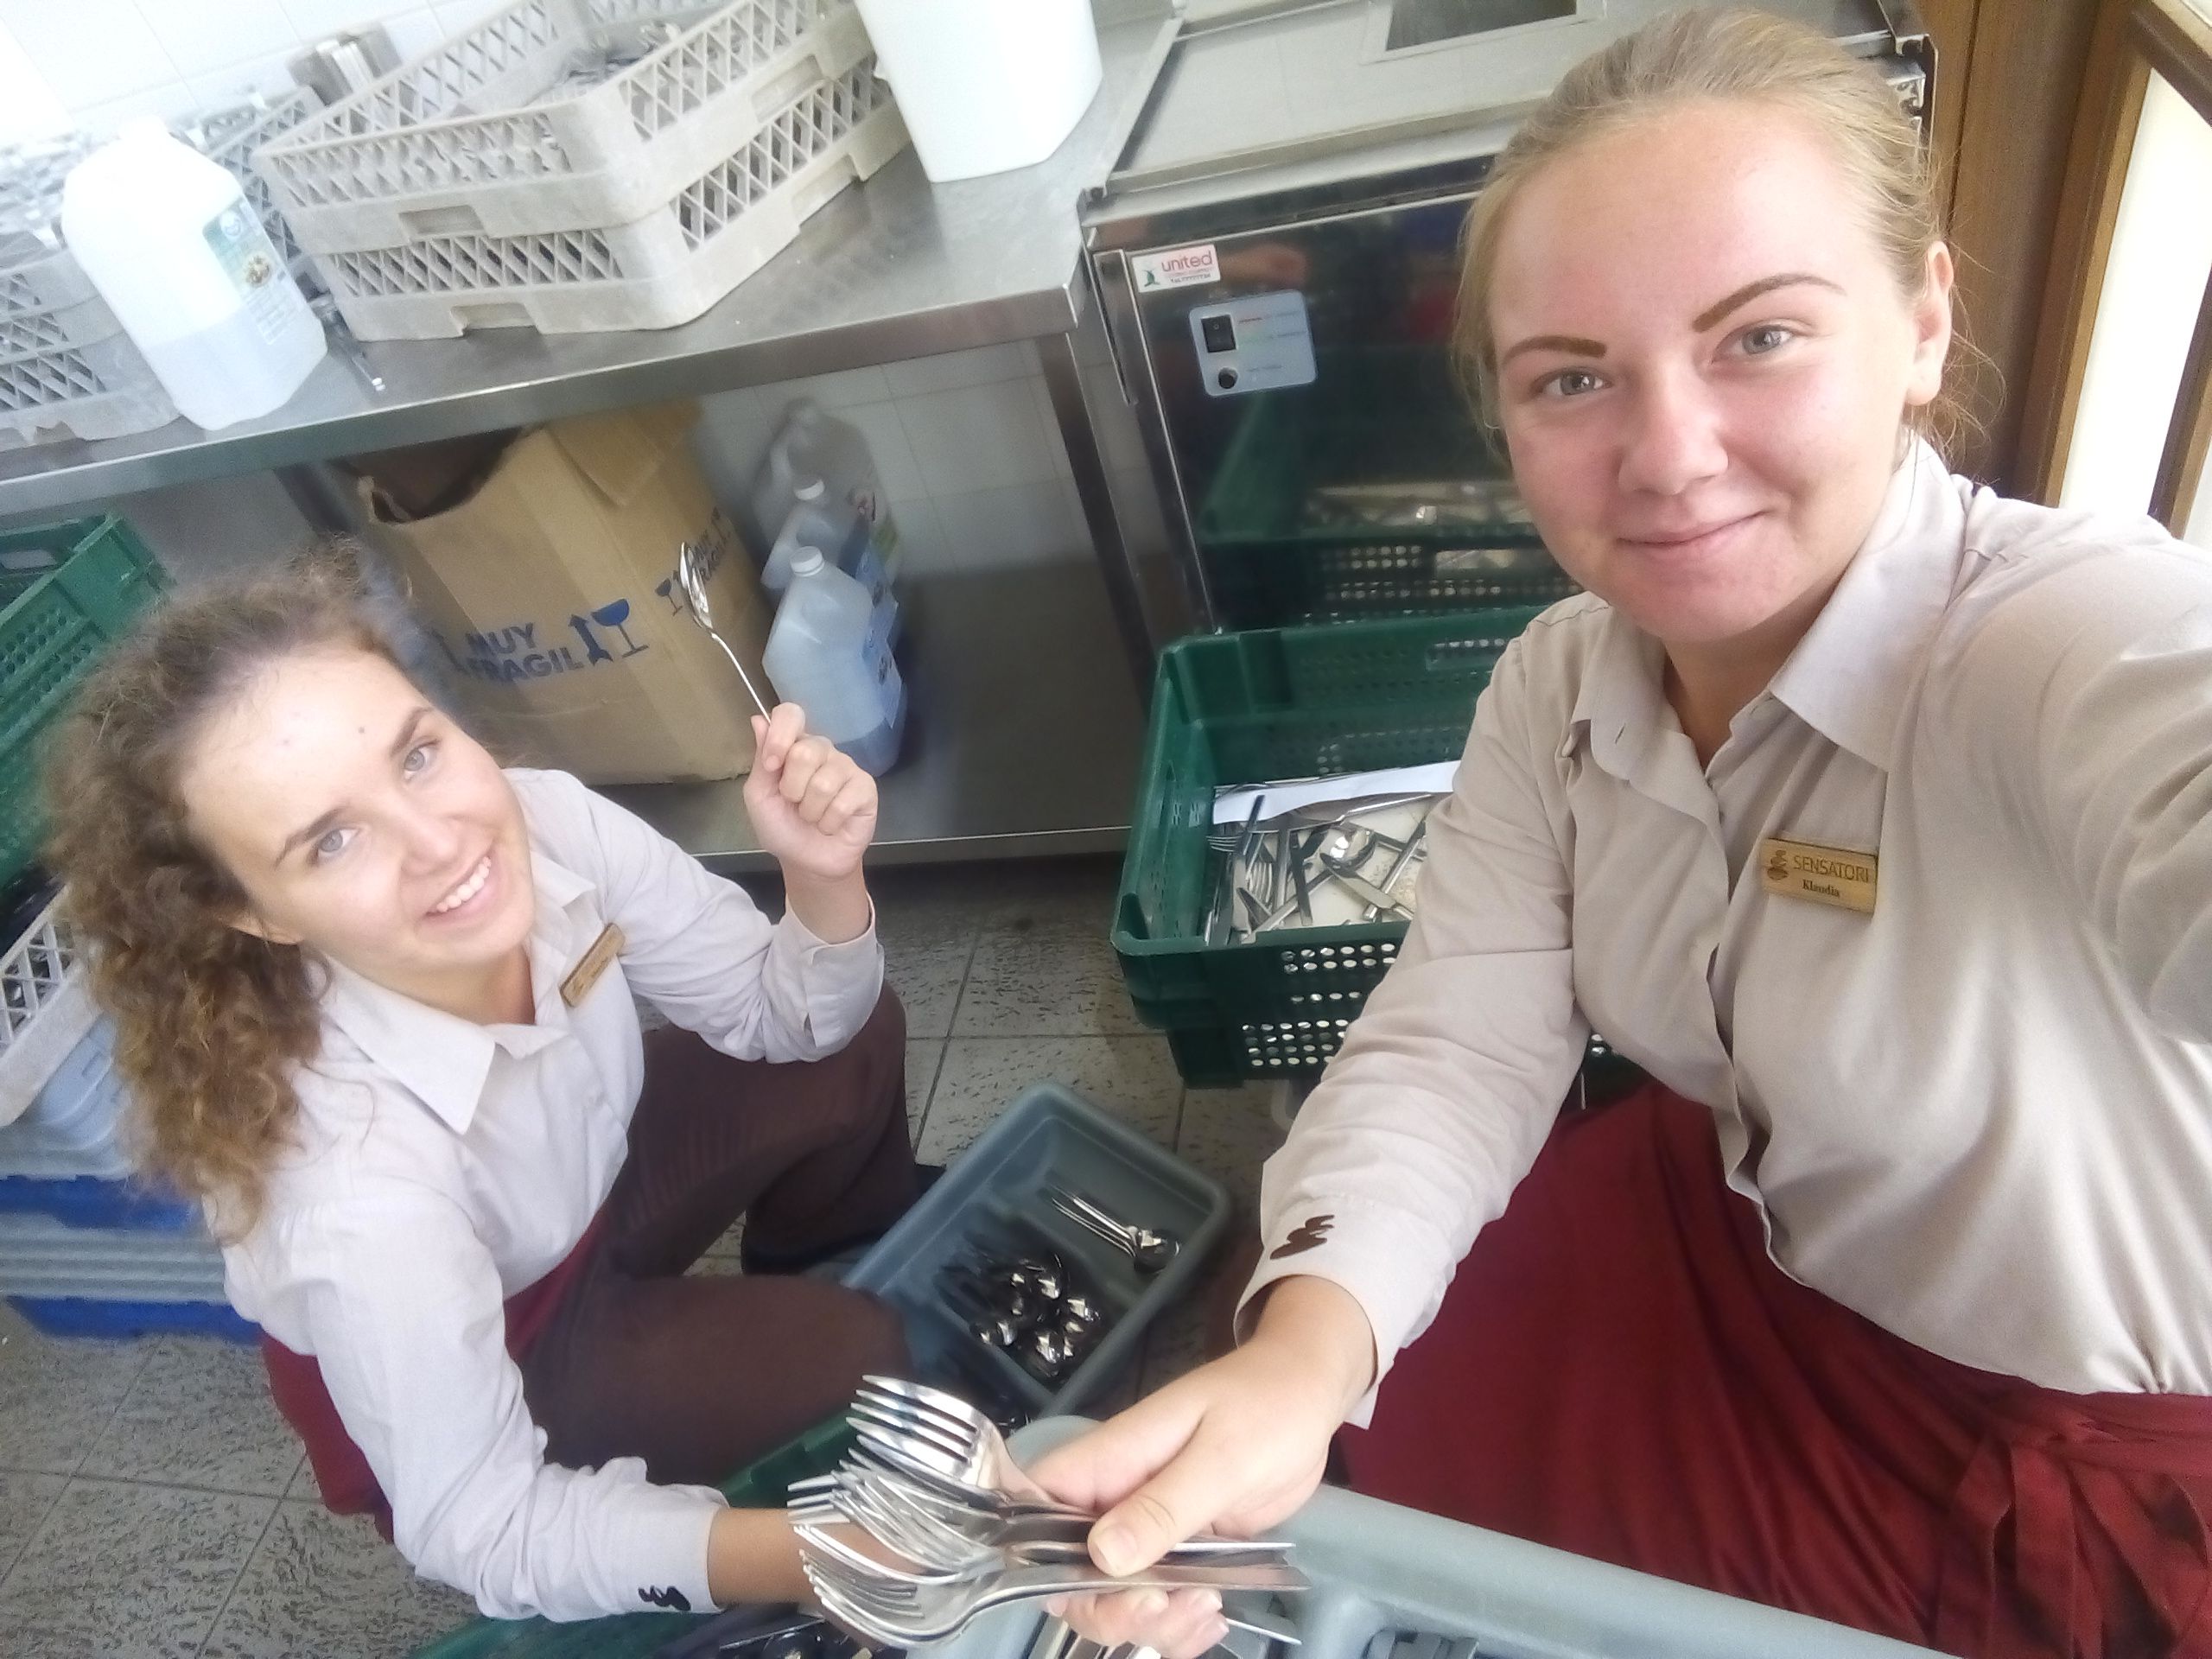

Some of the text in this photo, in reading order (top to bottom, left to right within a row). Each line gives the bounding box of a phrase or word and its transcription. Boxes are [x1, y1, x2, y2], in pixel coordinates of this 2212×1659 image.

[1161, 251, 1212, 271] united
[1793, 855, 1869, 883] SENSATORI
[1802, 879, 1840, 897] Klaudia
